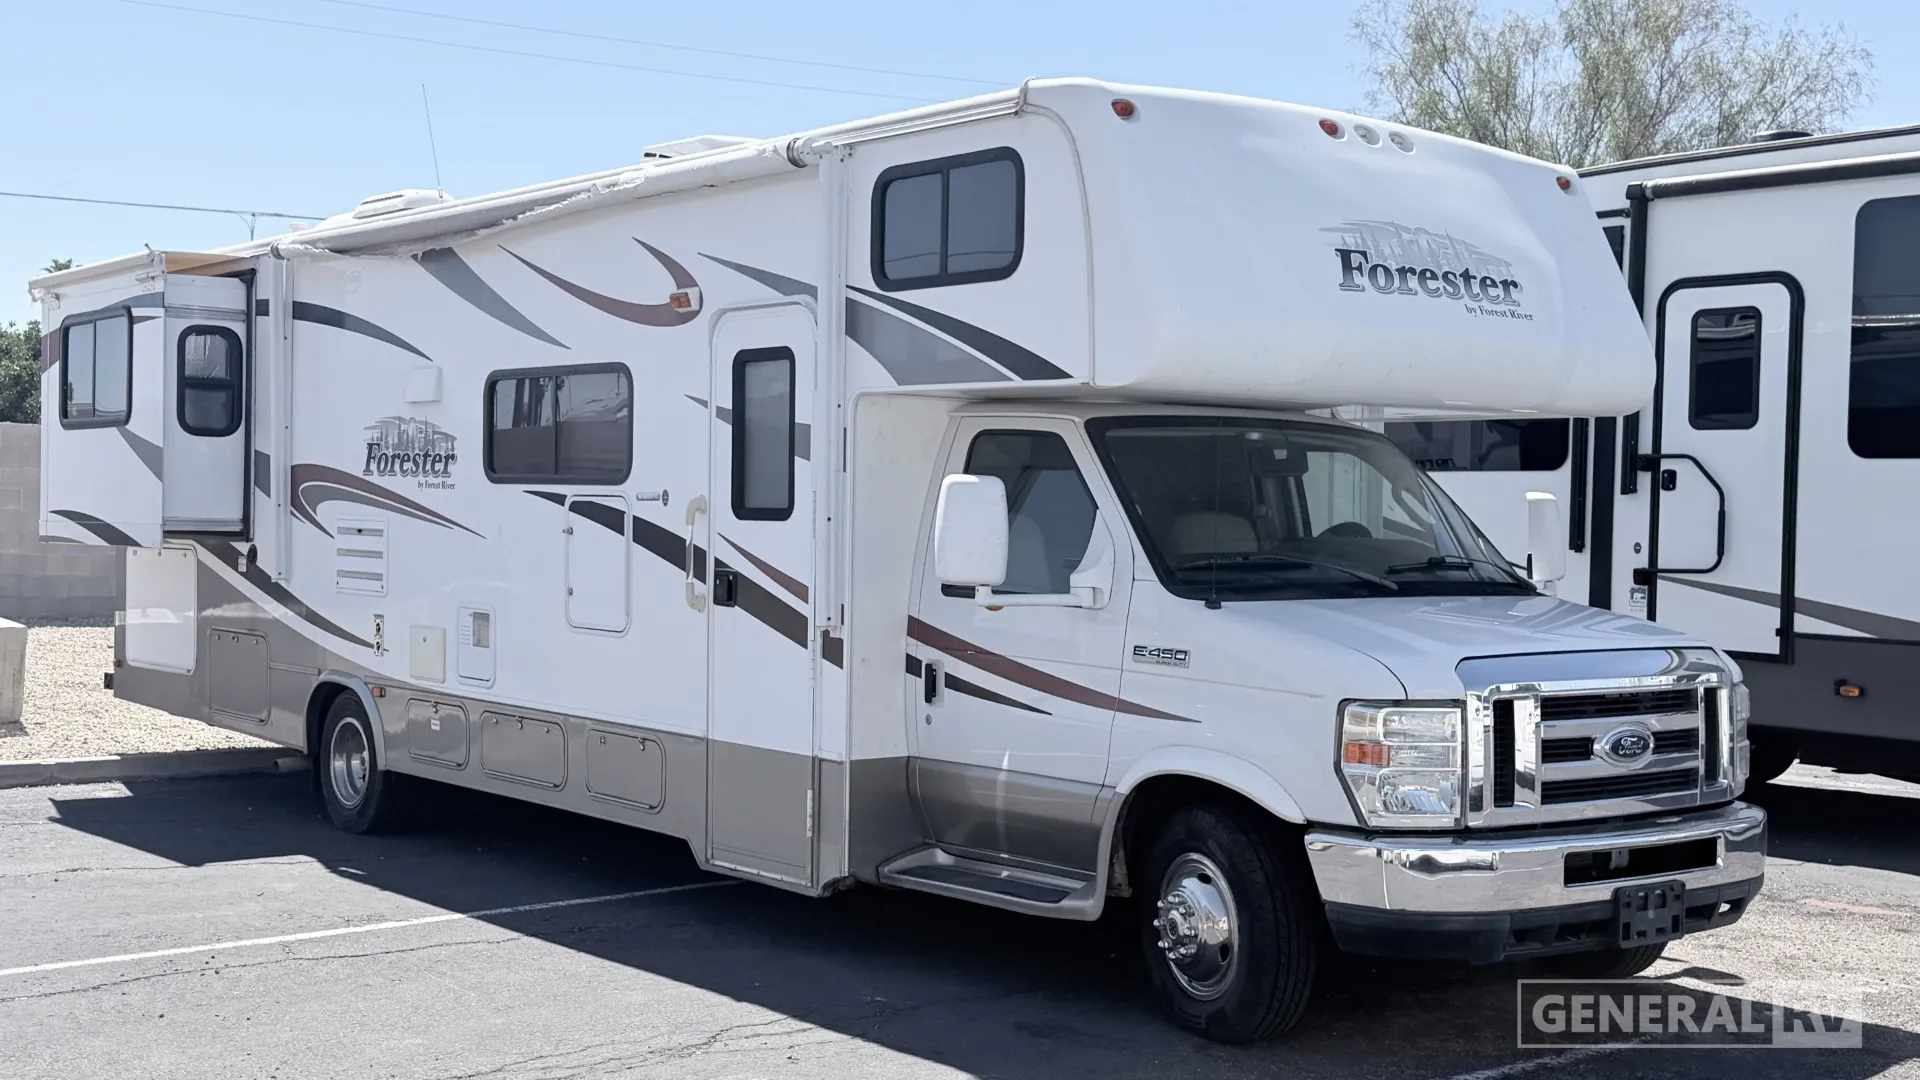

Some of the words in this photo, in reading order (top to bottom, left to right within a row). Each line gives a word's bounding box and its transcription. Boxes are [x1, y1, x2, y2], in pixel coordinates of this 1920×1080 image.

[1334, 247, 1521, 307] Forester
[1465, 303, 1477, 316] by
[1479, 304, 1508, 319] Forest
[1509, 307, 1534, 321] River
[362, 442, 457, 477] Forester
[417, 479, 424, 491] by
[424, 480, 441, 490] Forest
[441, 480, 456, 490] River
[1618, 736, 1644, 755] Ford
